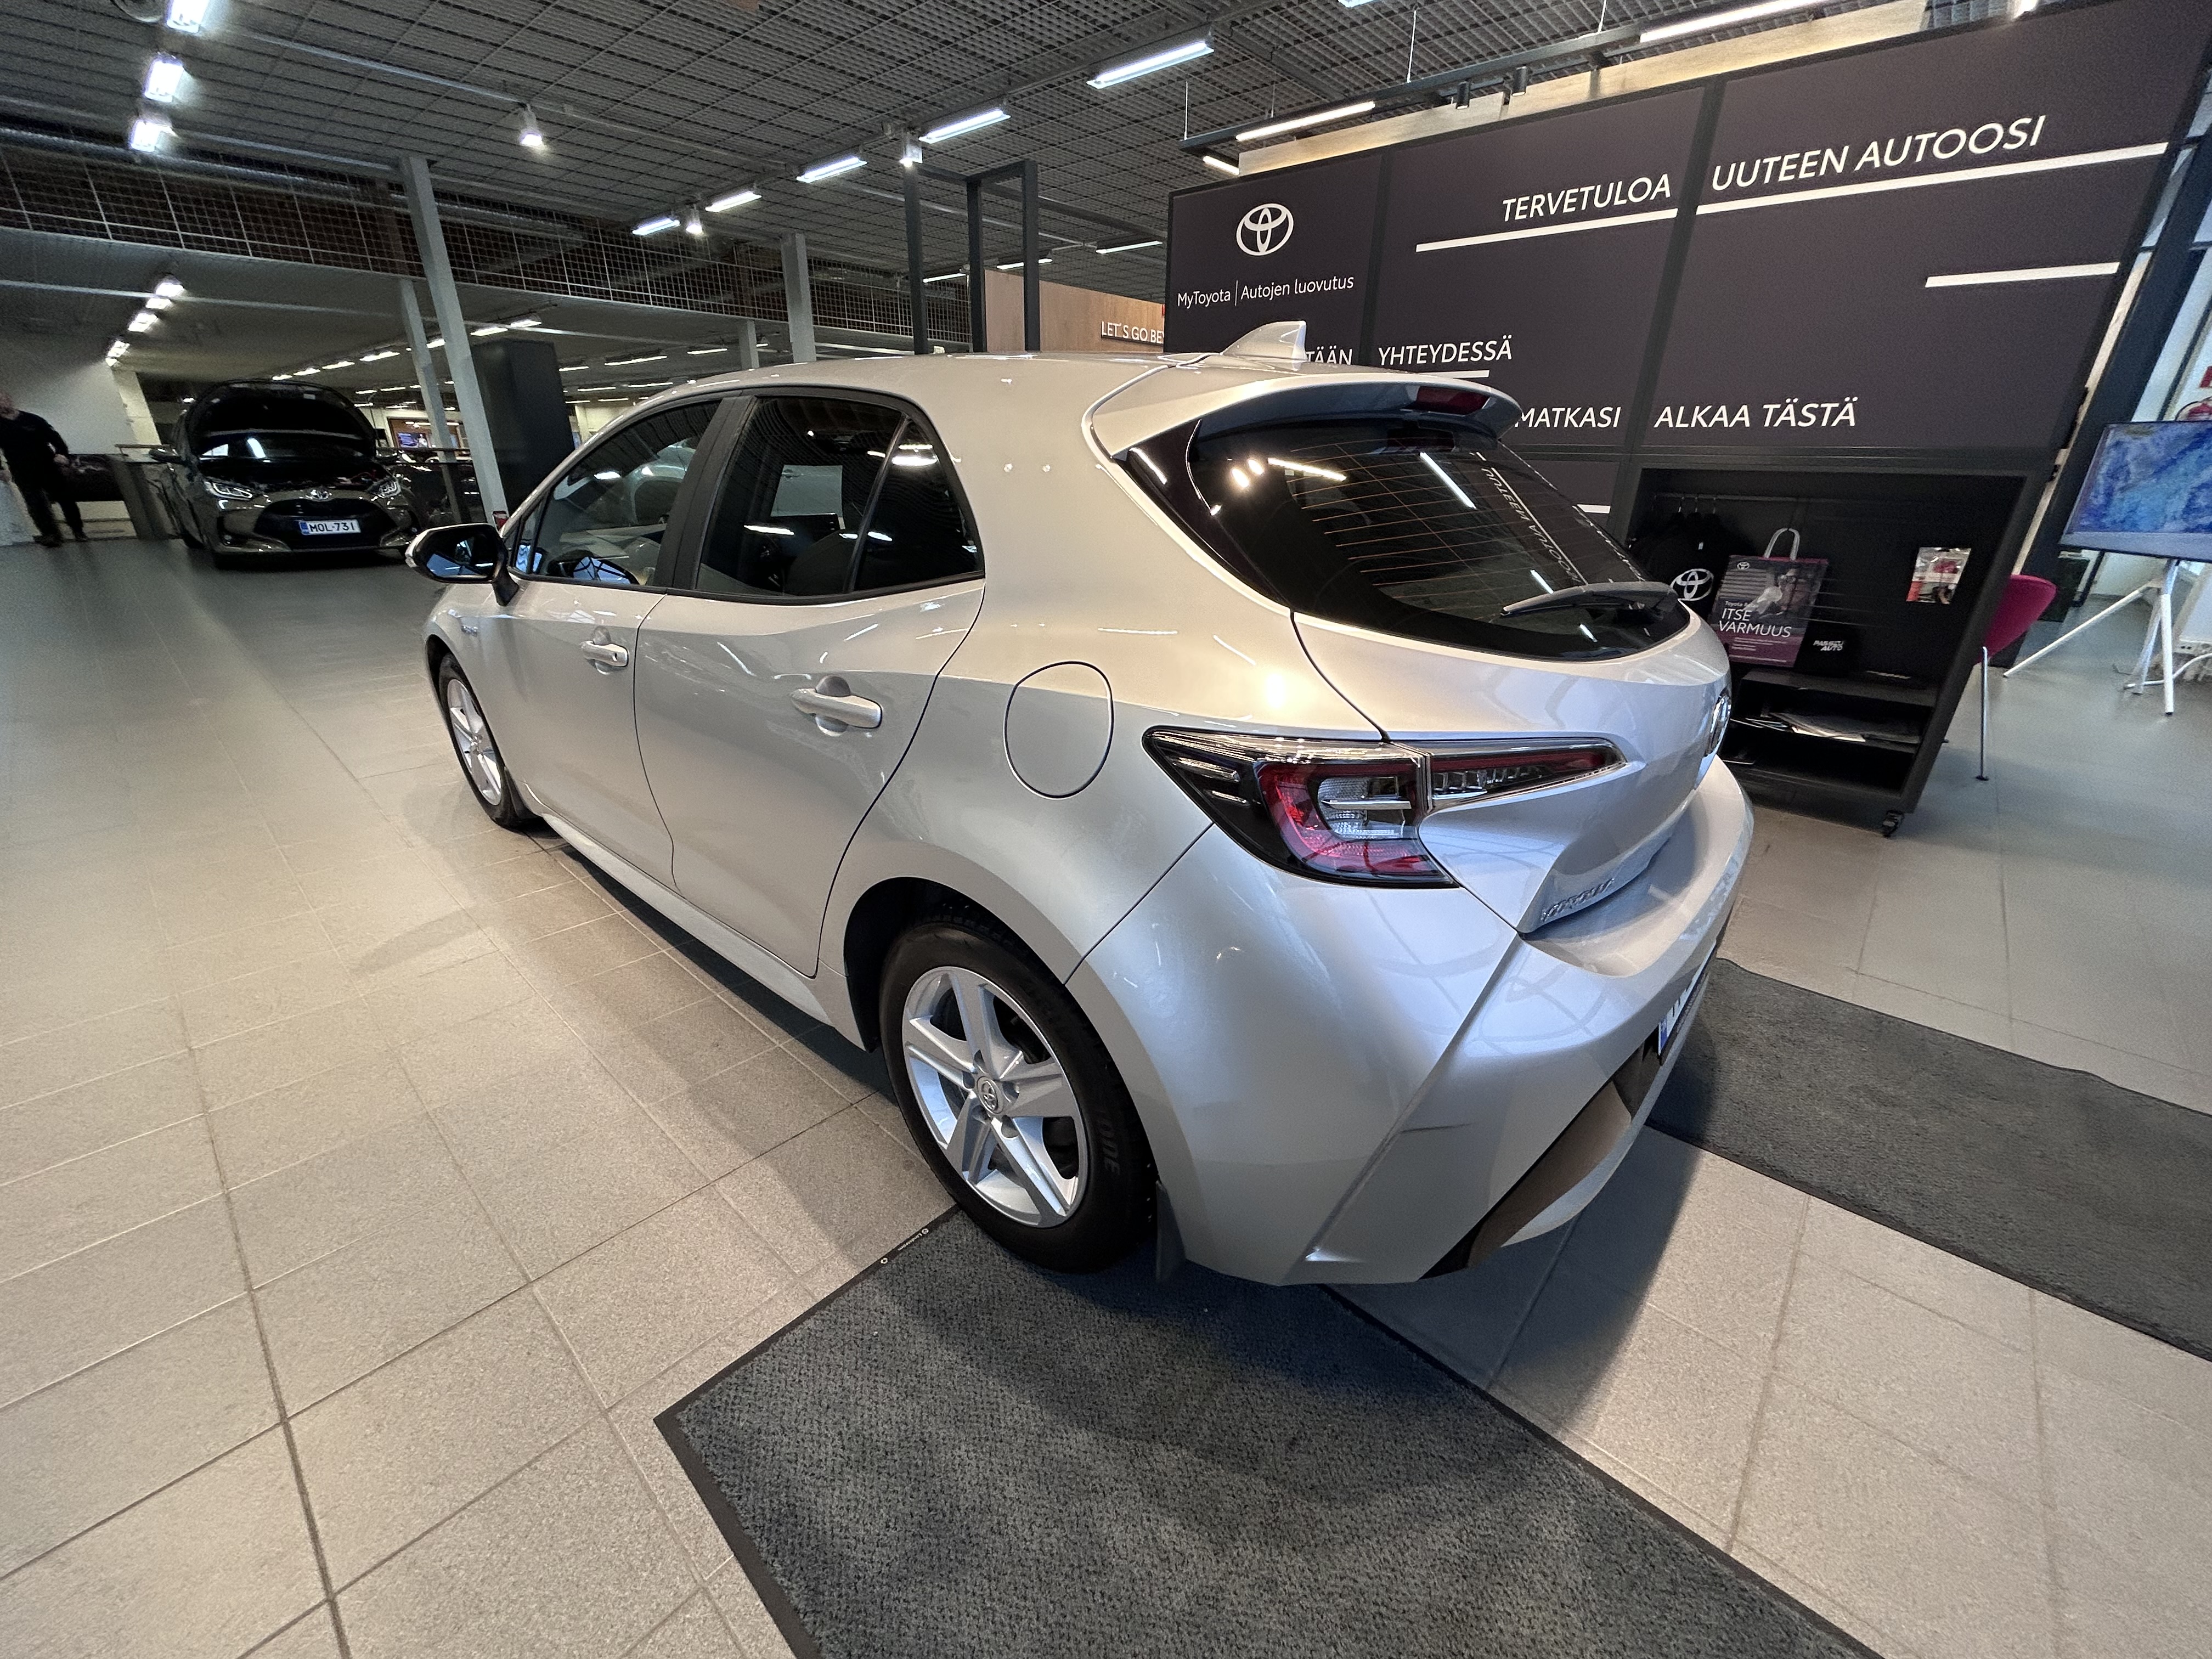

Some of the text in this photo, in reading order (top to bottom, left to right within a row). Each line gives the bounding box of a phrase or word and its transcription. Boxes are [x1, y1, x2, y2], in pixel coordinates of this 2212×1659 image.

[1503, 115, 2046, 221] TERVETULOA UUTEEN AUTOOSI
[1177, 276, 1354, 309] MyToyota Autojen luovutus
[1131, 326, 1148, 342] GO
[1150, 329, 1164, 345] BE
[1378, 335, 1512, 366] YHTEYDESSÄ
[1515, 396, 1858, 428] MATKASI ALKAA TÄSTÄ
[309, 522, 355, 532] MOL-731
[1722, 608, 1752, 621] ITSE
[1719, 620, 1792, 638] VARMUUS
